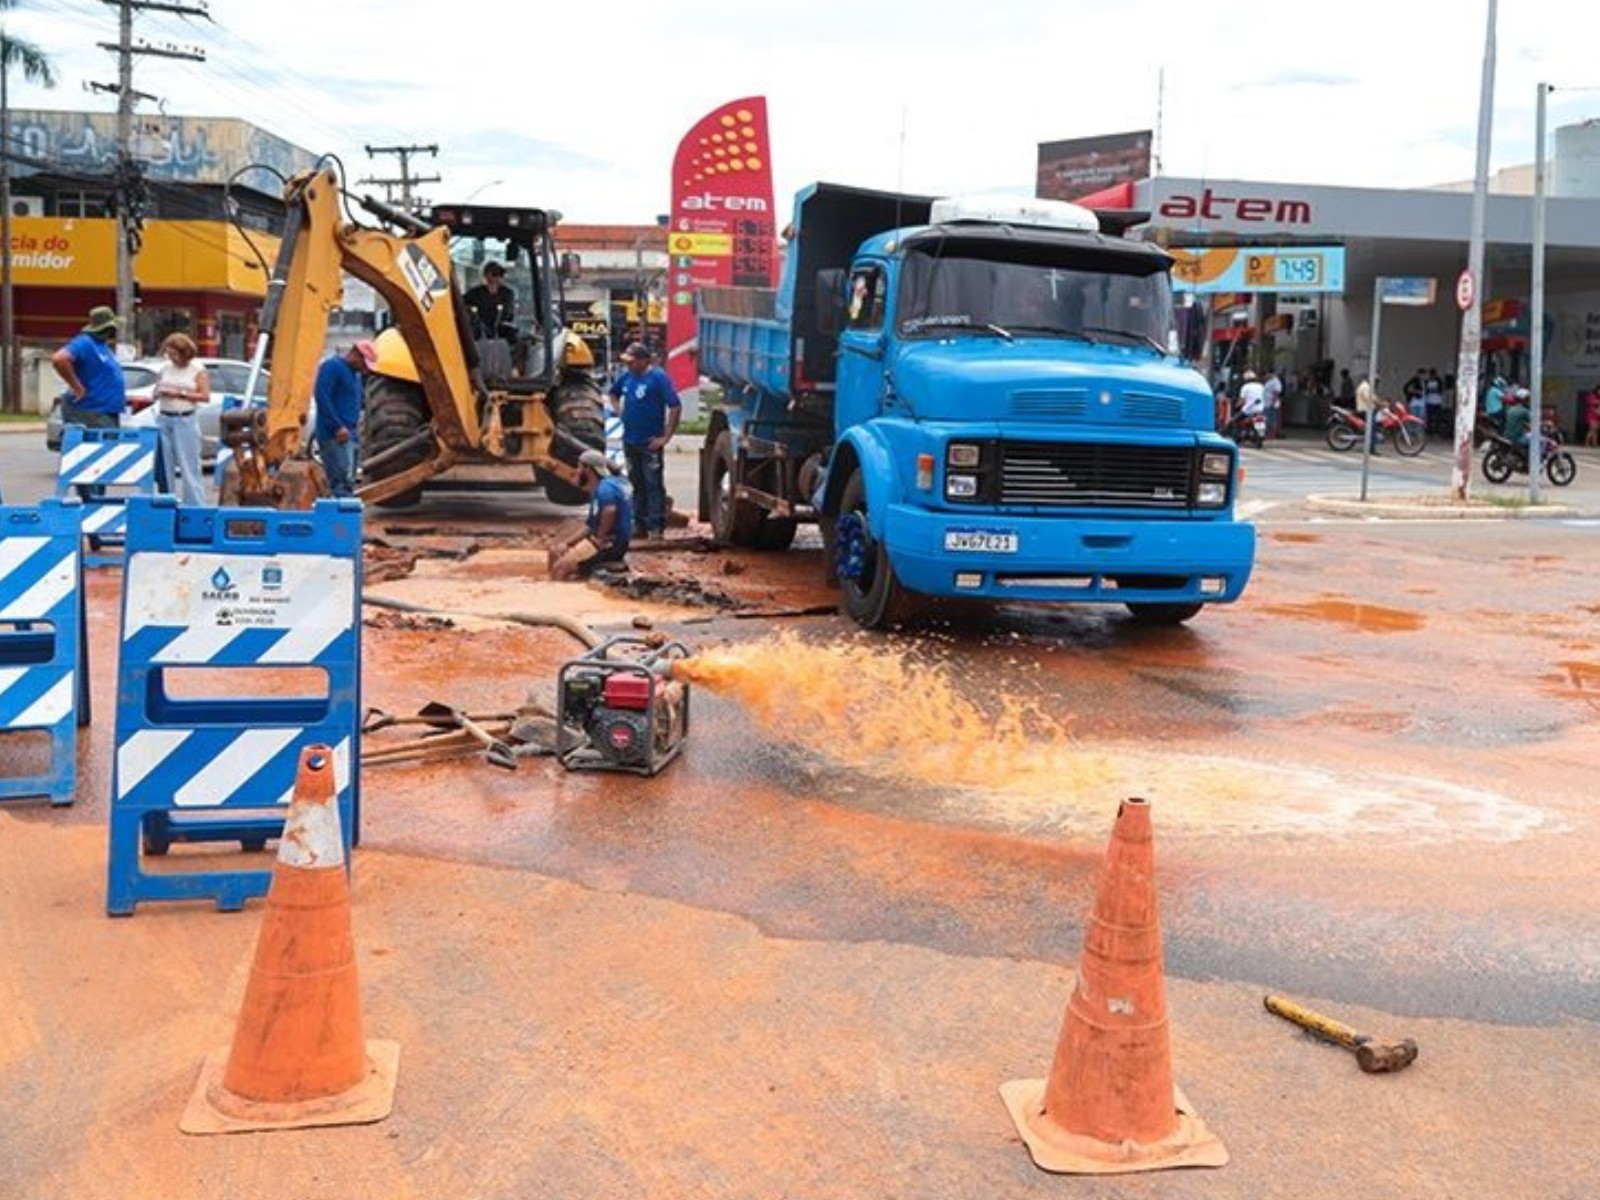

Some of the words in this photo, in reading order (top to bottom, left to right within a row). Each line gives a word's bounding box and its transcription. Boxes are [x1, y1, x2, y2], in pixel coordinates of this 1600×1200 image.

[681, 192, 767, 212] atem
[1159, 189, 1311, 223] atem
[11, 234, 37, 250] cia
[44, 234, 69, 251] do
[12, 251, 74, 269] midor
